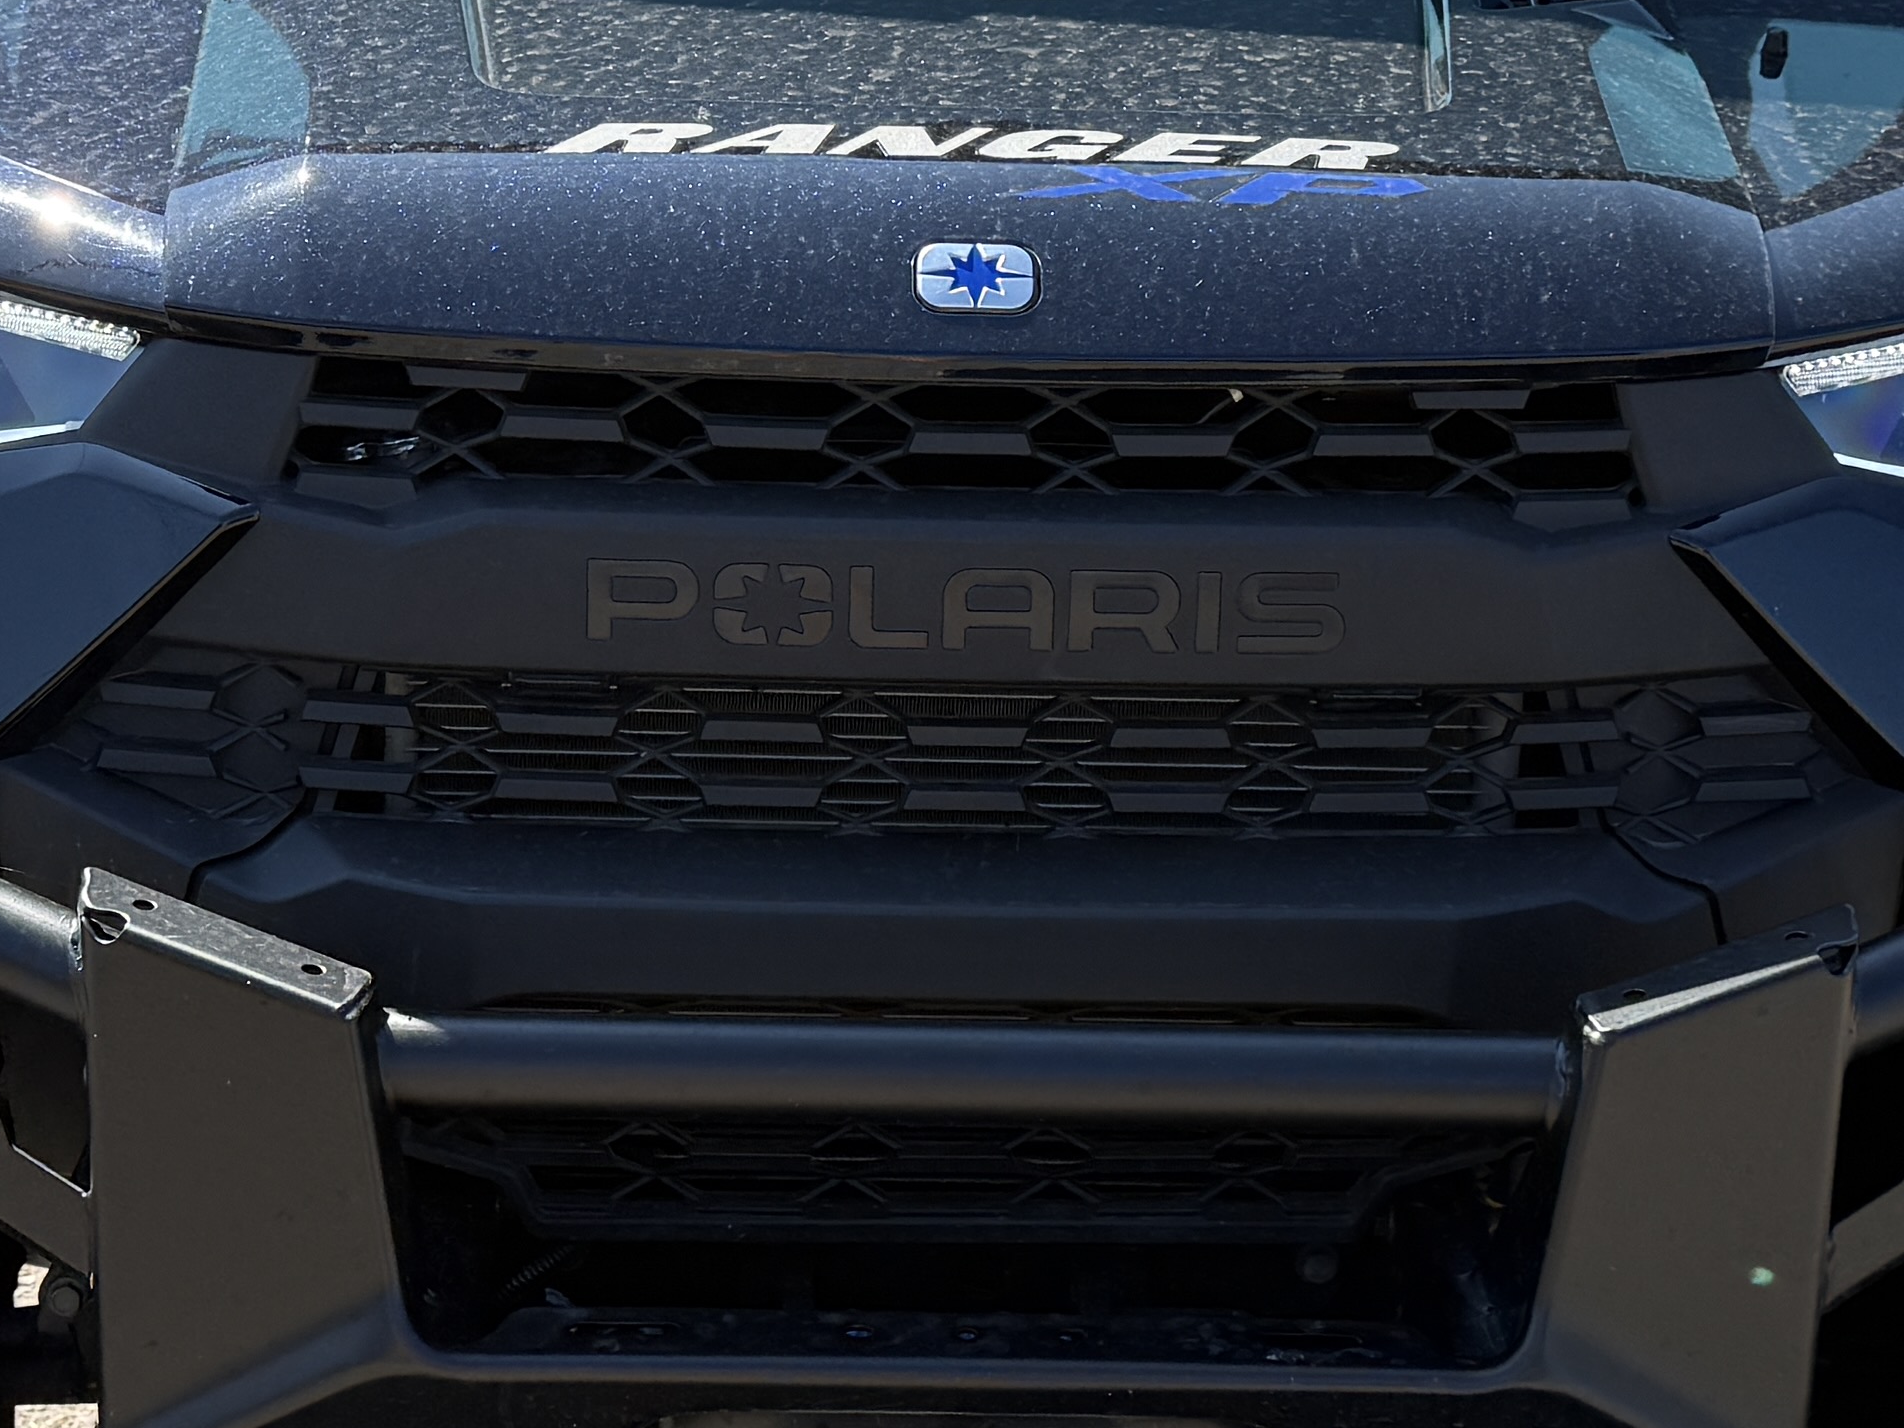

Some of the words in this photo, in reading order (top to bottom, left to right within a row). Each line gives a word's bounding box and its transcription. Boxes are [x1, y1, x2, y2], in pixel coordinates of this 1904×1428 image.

[542, 121, 1402, 172] RANGER
[1018, 163, 1432, 206] XP
[586, 556, 1348, 655] POLARIS
